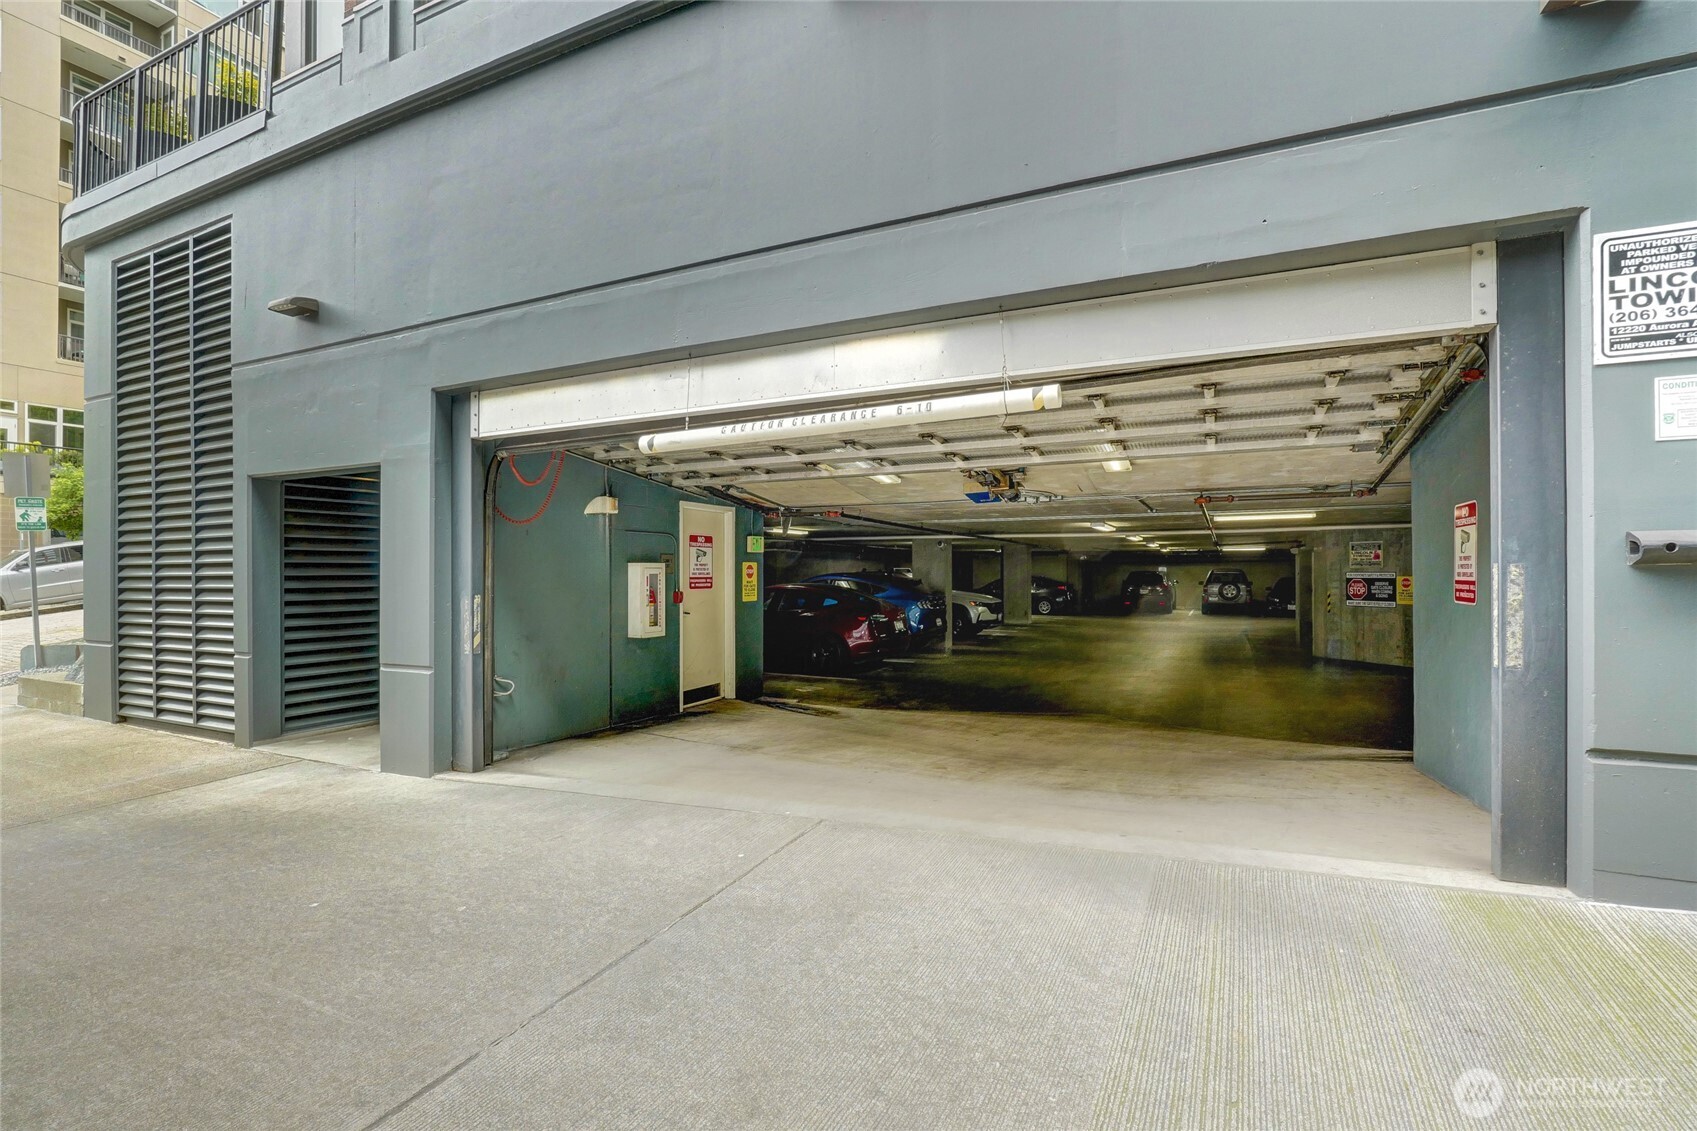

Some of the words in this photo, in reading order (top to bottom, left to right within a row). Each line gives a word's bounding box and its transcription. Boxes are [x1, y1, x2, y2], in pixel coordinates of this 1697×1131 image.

[1621, 251, 1696, 266] IMPOUNDED
[1627, 246, 1677, 258] PARKED
[1620, 266, 1638, 275] AT
[1640, 260, 1694, 272] OWNERS
[1609, 287, 1696, 310] TOWI
[1609, 309, 1657, 324] (206)
[1611, 324, 1647, 335] 12220
[1648, 322, 1689, 331] Aurora
[1611, 338, 1677, 351] JUMPSTARTS
[721, 418, 784, 434] CAUTION
[792, 408, 877, 427] CLEARANCE
[1349, 587, 1366, 595] STOP
